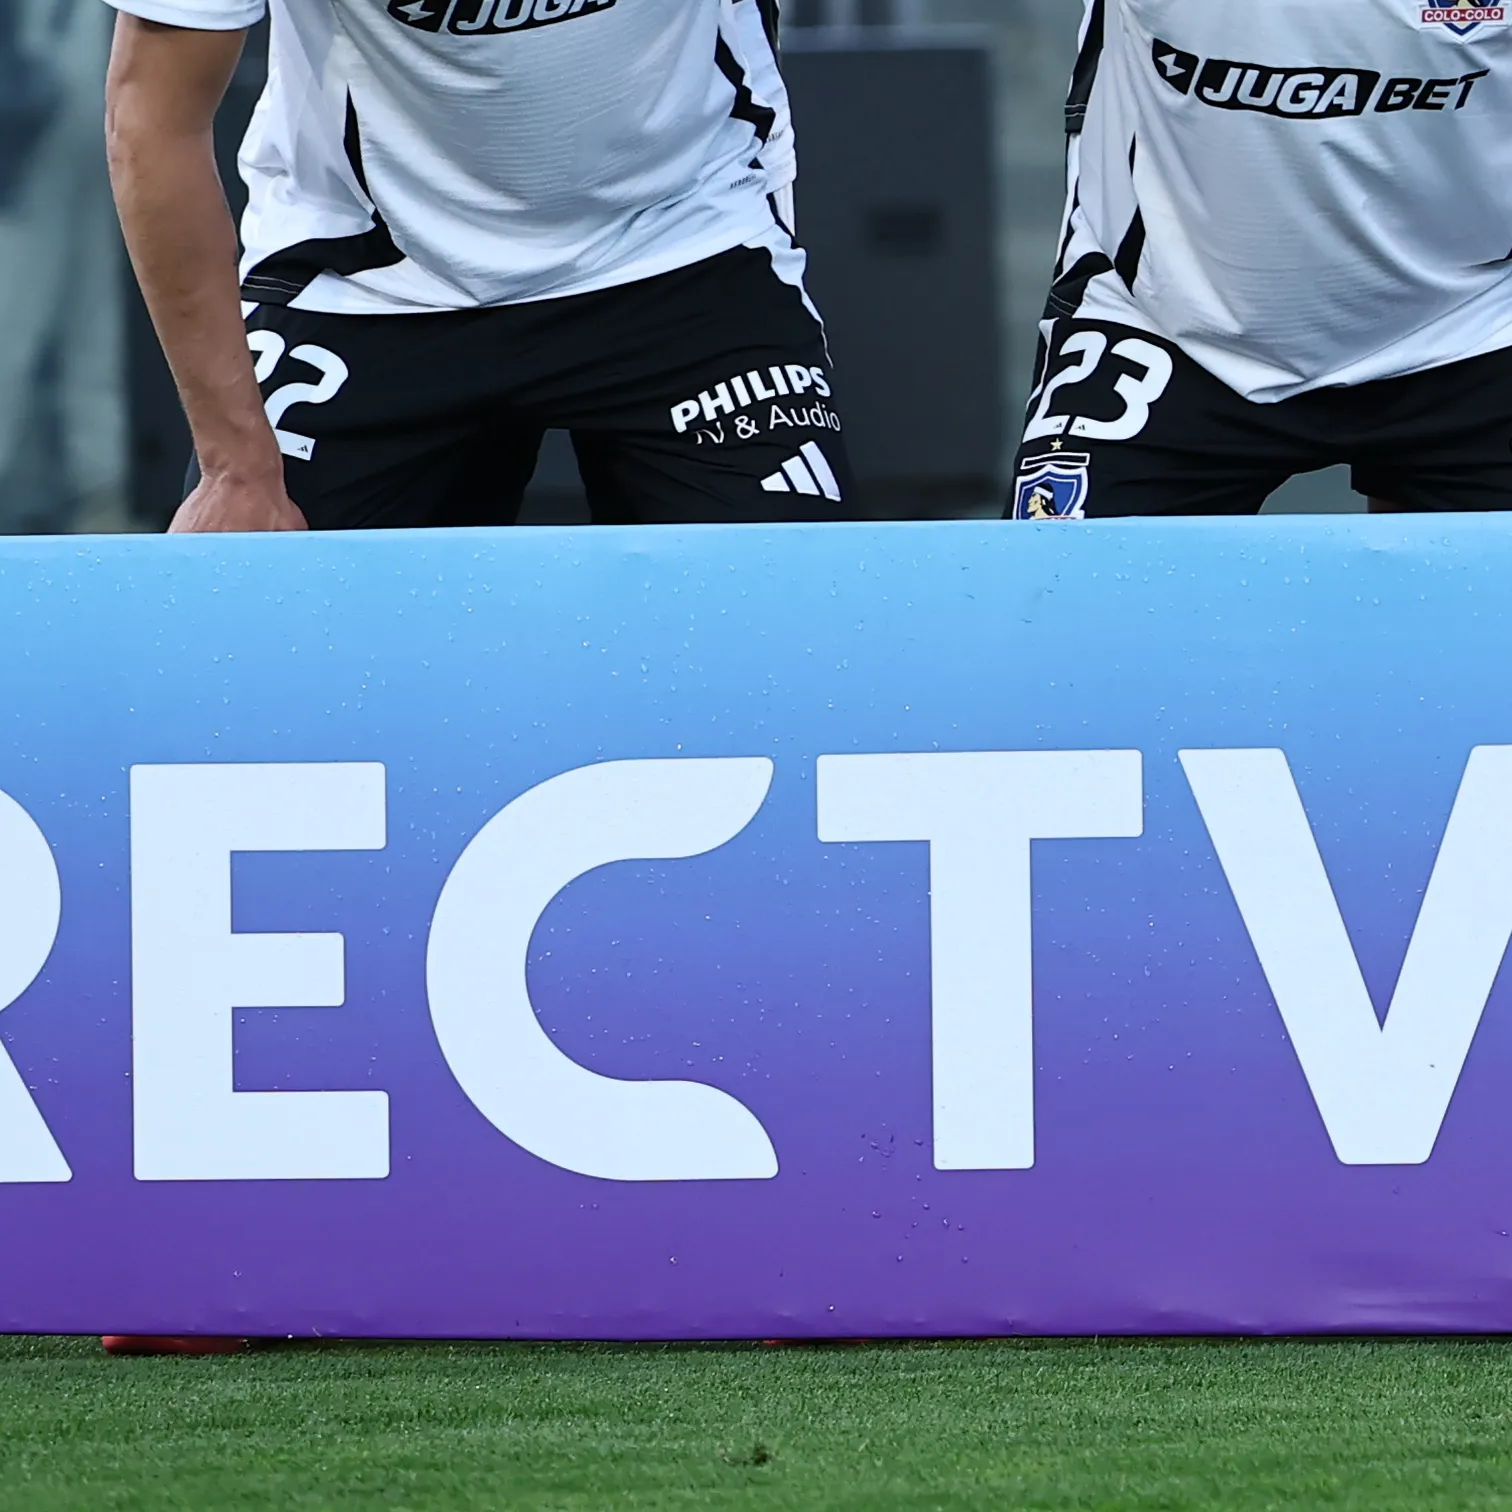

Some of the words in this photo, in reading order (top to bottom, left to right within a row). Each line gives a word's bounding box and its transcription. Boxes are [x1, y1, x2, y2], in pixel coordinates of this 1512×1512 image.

[1424, 8, 1502, 22] COLO-COLO
[670, 364, 832, 434] PHILIPS
[1022, 331, 1174, 443] 23
[734, 415, 760, 440] &
[769, 401, 842, 432] Audio
